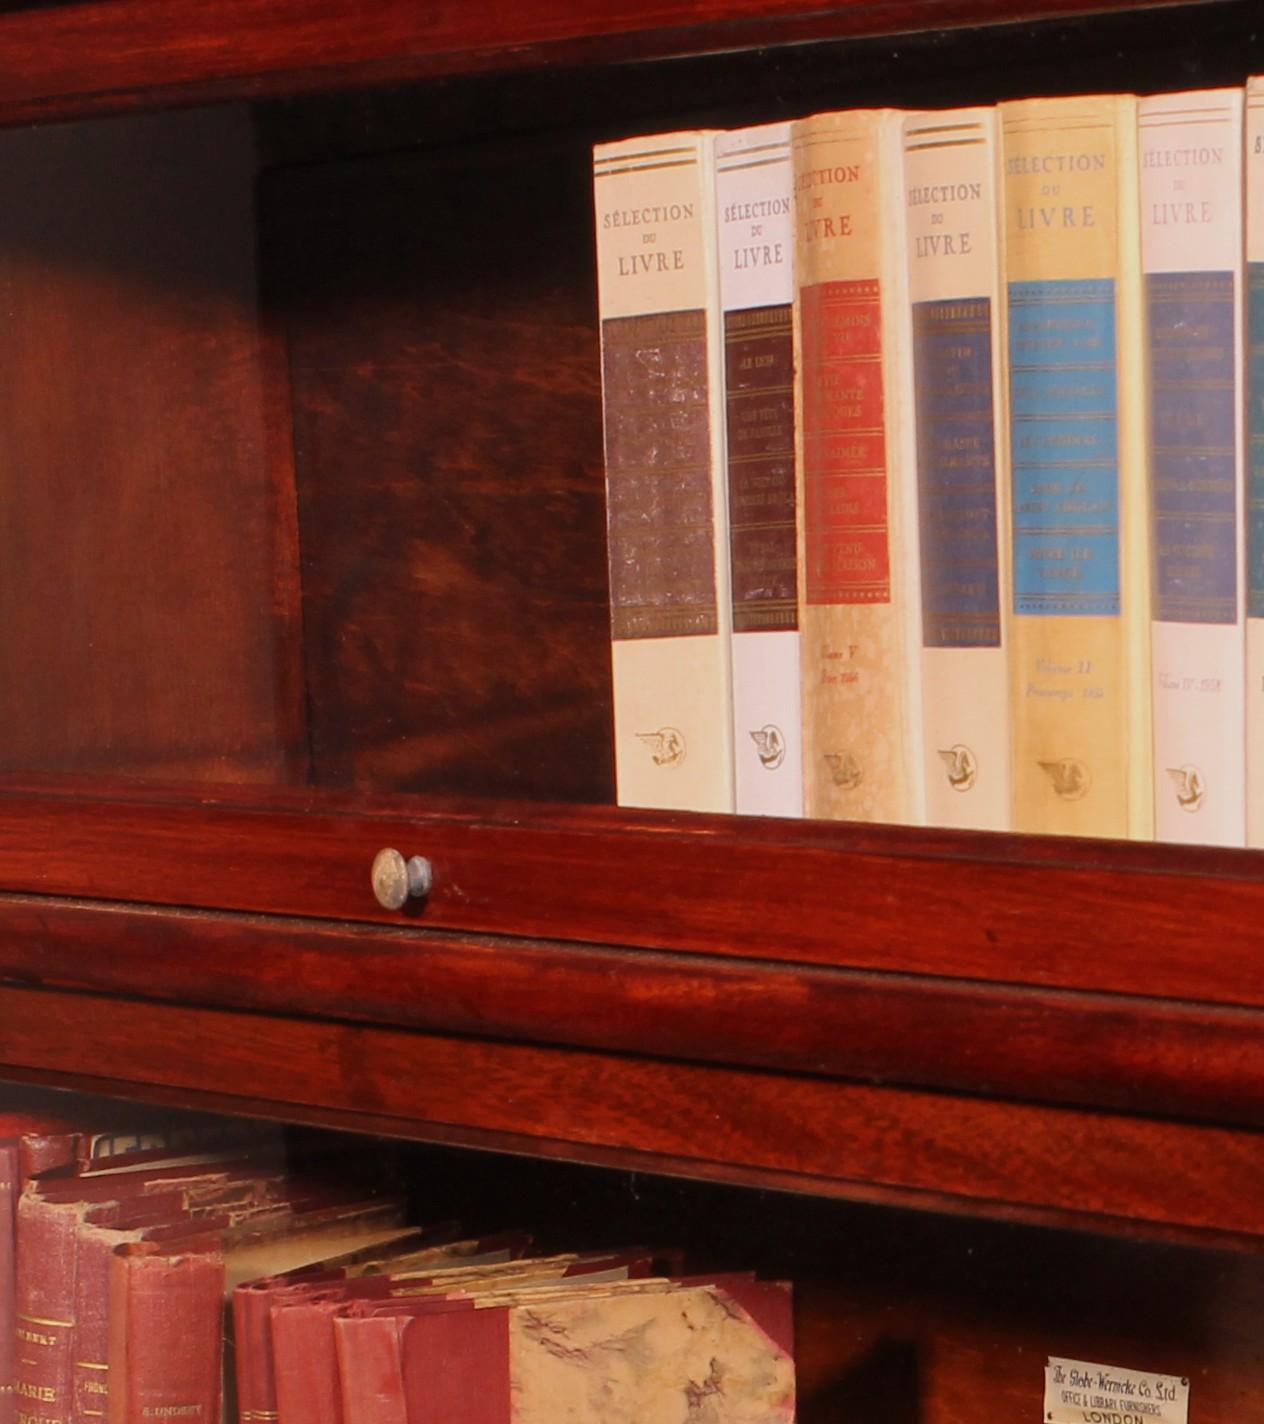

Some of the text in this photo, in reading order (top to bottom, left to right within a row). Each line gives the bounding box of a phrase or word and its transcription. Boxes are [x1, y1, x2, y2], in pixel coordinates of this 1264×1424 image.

[603, 203, 695, 229] SÉLECTION
[724, 197, 791, 223] SÉLECTION
[1017, 205, 1096, 230] LIVRE
[1152, 201, 1213, 225] LIVRE
[734, 243, 783, 270] LIVRE
[915, 233, 972, 258] LIVRE
[618, 250, 684, 276] LIVRE
[1090, 1394, 1119, 1411] LIBRARY
